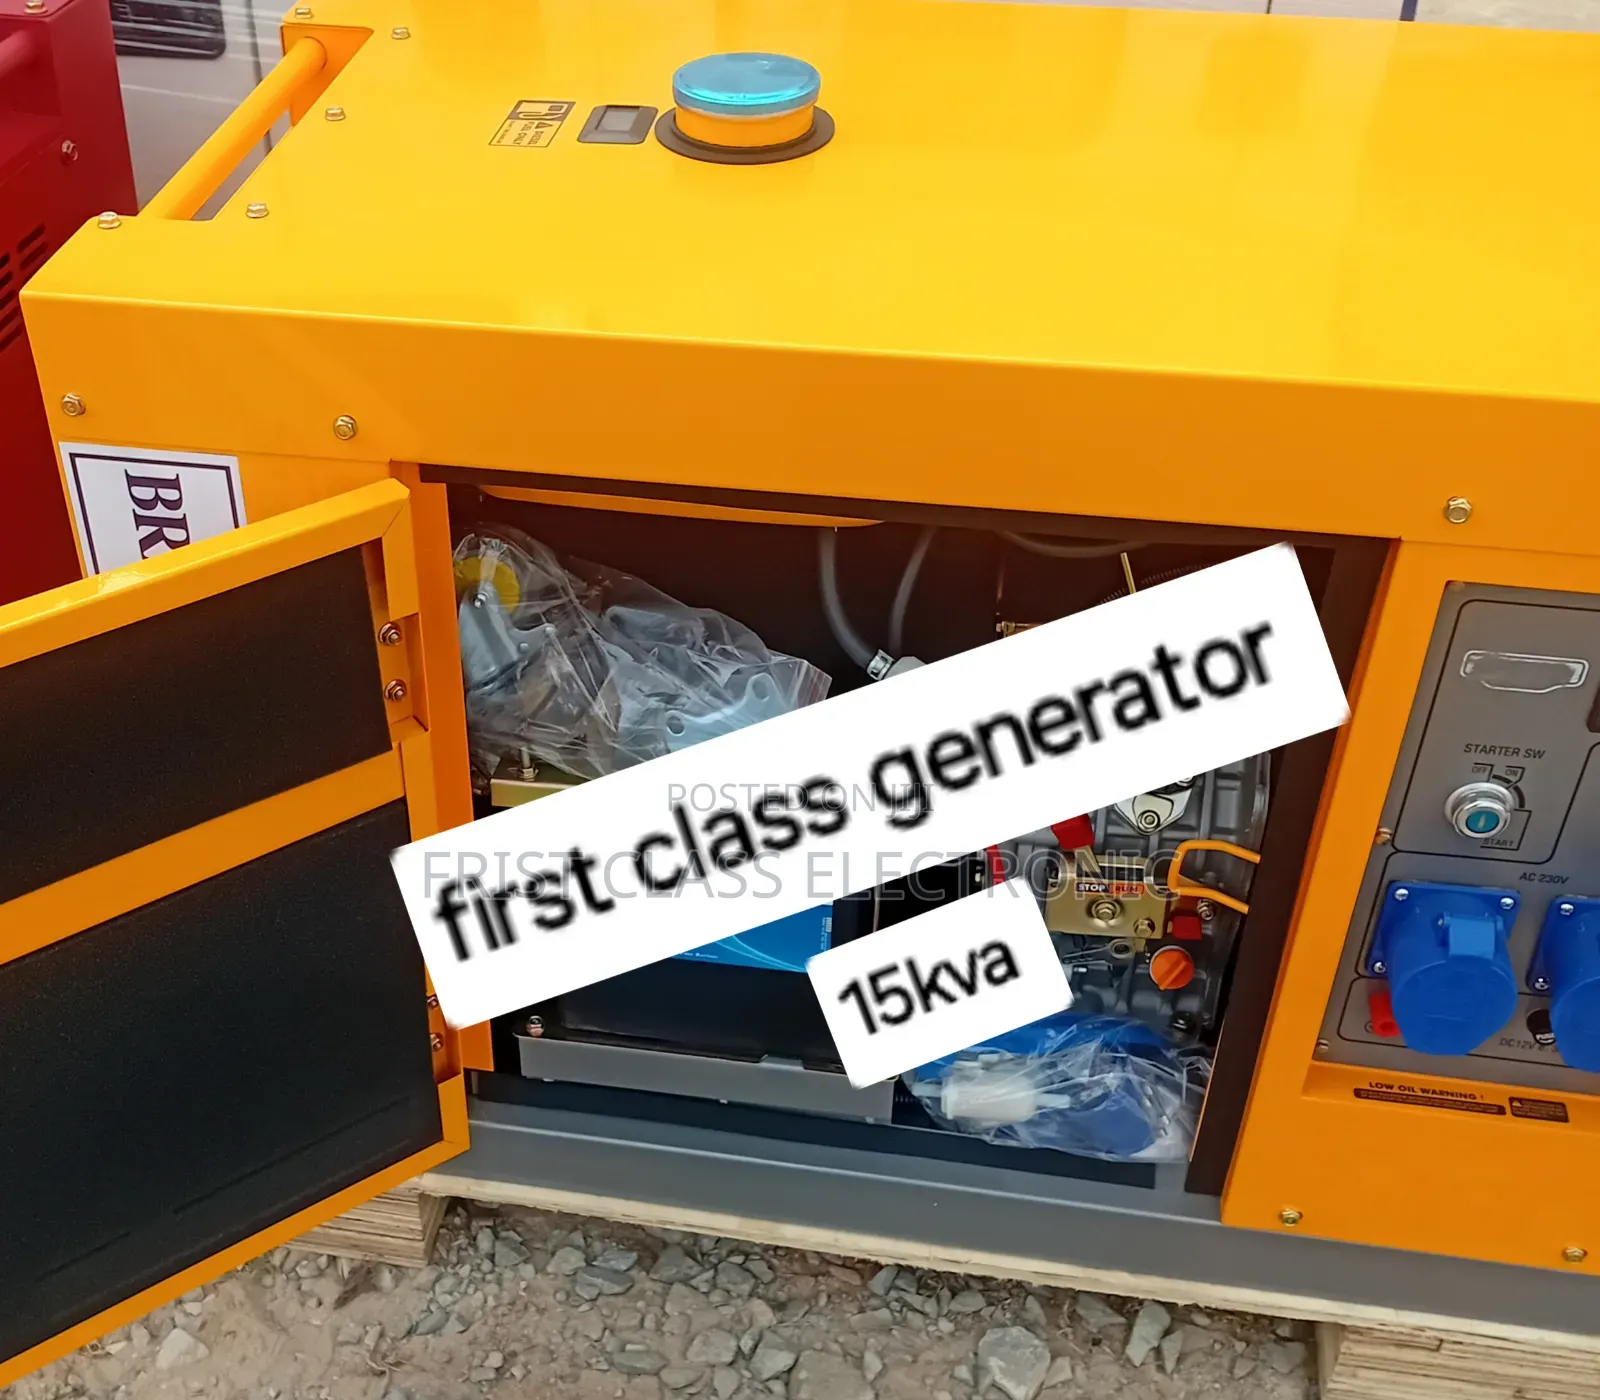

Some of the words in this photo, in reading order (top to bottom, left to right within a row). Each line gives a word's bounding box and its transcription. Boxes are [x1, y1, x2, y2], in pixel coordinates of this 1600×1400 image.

[1463, 743, 1521, 757] STARTER
[1523, 748, 1546, 759] SW
[1472, 766, 1488, 774] OFF
[1505, 769, 1519, 777] ON
[1482, 838, 1514, 848] START
[1519, 871, 1537, 882] AC
[1538, 873, 1570, 885] 230V
[1078, 883, 1106, 892] STOP
[1115, 885, 1139, 894] RUN
[1369, 1081, 1395, 1090] LOW
[1398, 1084, 1417, 1094] OIL
[1420, 1087, 1477, 1101] WARNING
